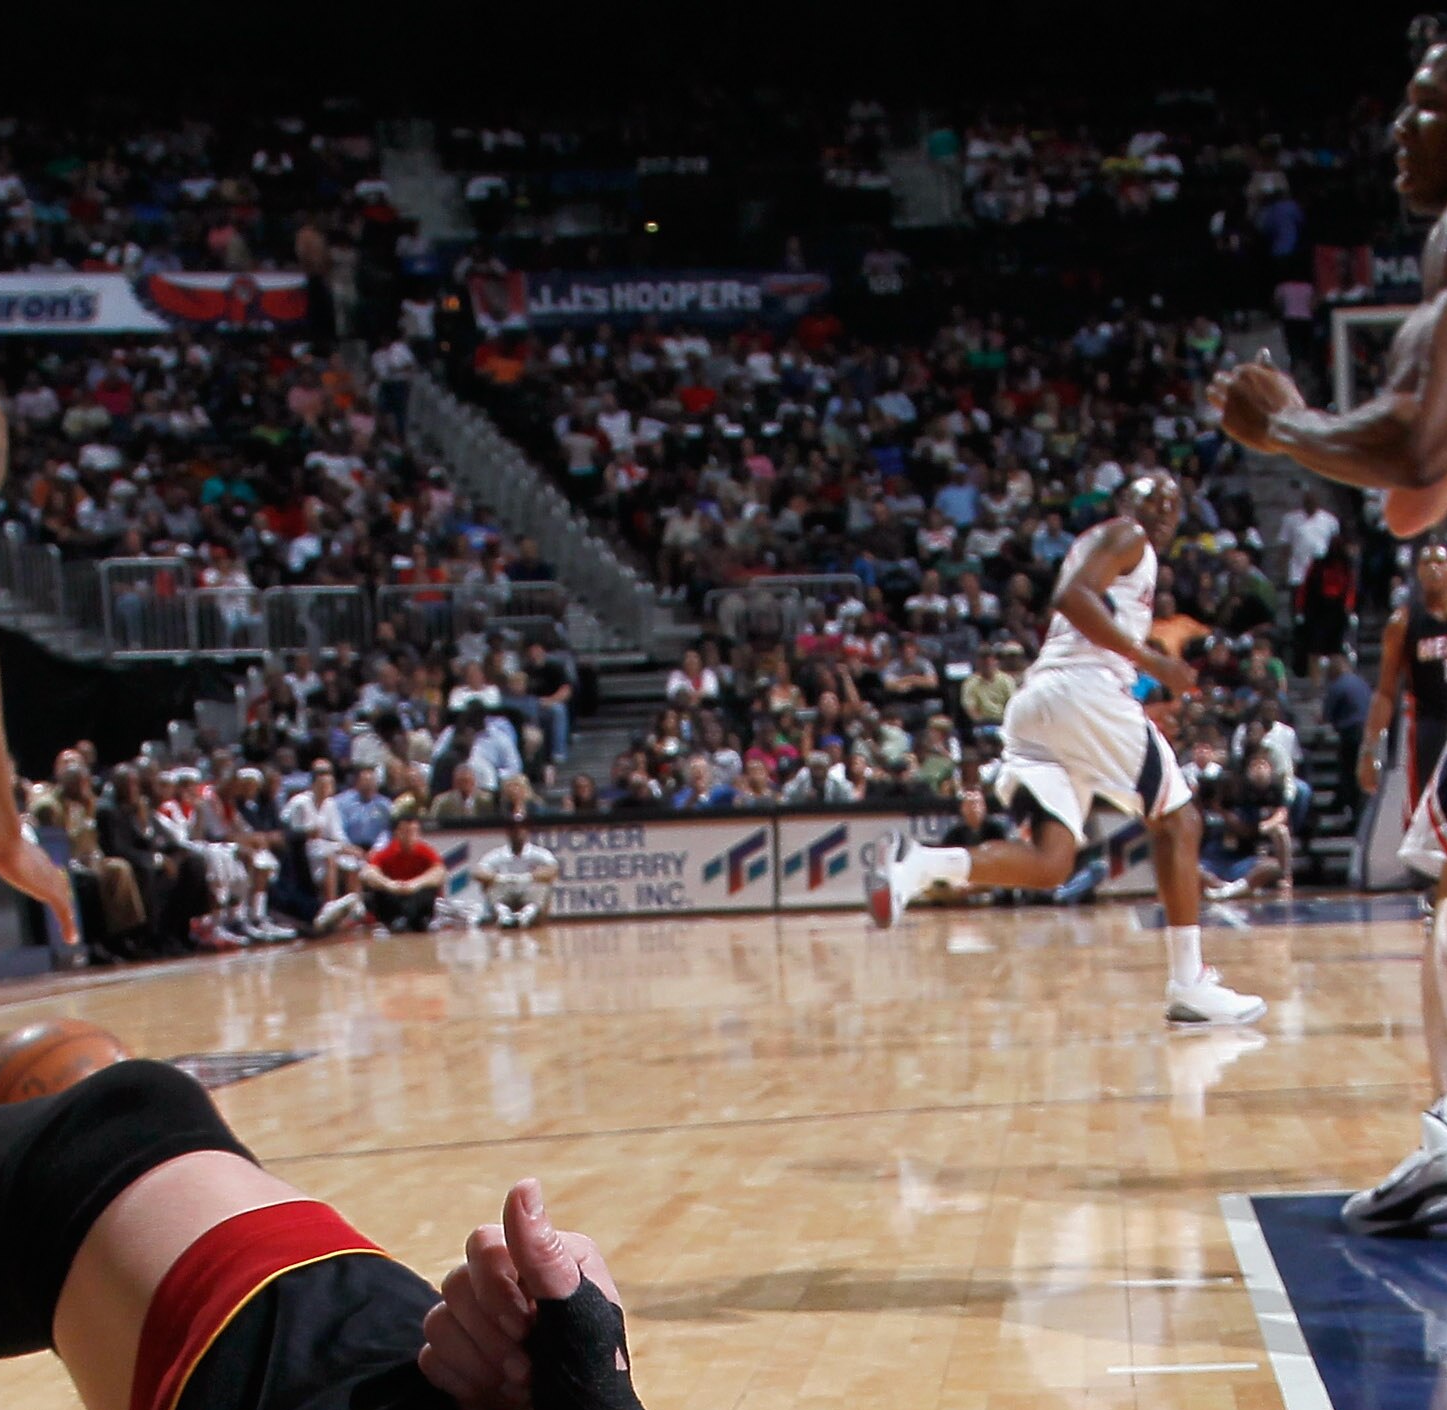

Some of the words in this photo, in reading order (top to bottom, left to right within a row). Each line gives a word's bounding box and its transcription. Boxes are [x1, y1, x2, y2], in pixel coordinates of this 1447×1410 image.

[1372, 256, 1419, 284] MA
[558, 850, 689, 881] LEBERRY
[553, 884, 621, 912] TING,
